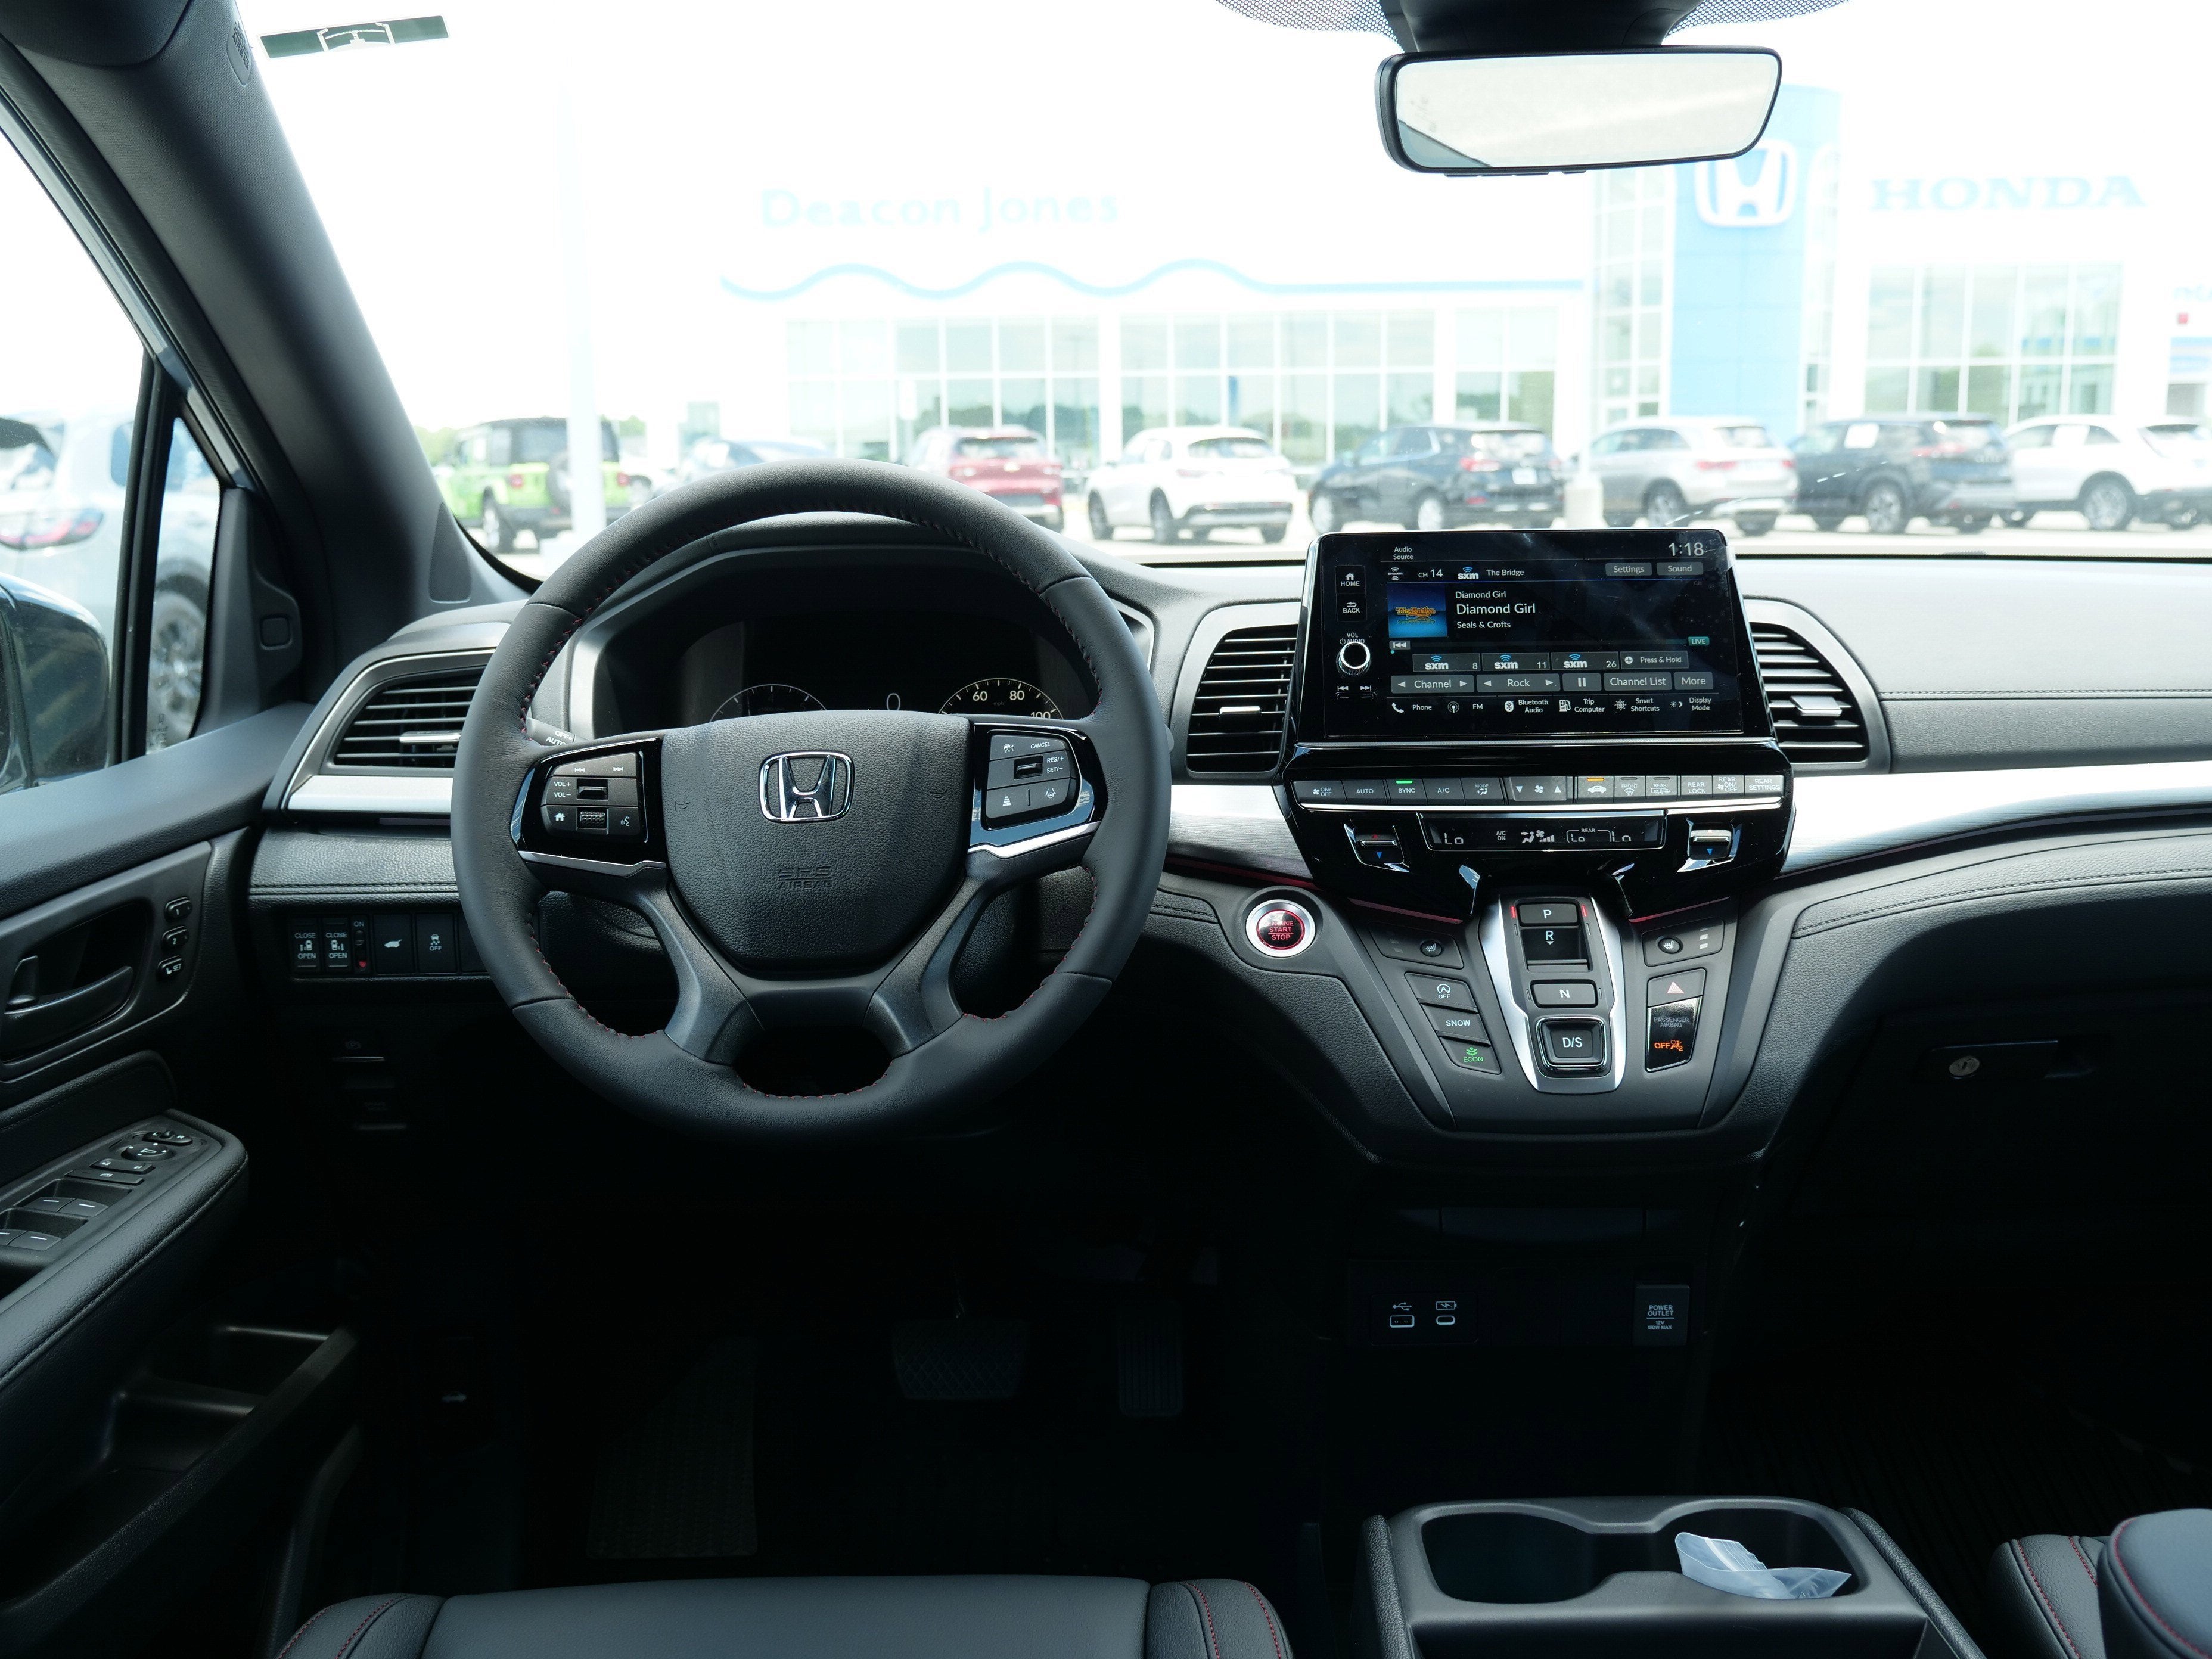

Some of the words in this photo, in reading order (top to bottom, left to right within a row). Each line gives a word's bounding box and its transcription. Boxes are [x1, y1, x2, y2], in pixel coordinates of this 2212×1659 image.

[1869, 175, 2149, 213] HONDA
[761, 188, 961, 228] Deacon
[977, 185, 1119, 234] Jones
[1669, 542, 1704, 557] 1:18
[1430, 569, 1443, 578] 14
[1502, 569, 1524, 577] Bridge
[1613, 566, 1645, 574] Settings
[1455, 591, 1490, 599] Diamond
[1456, 604, 1511, 614] Diamond
[1514, 603, 1536, 614] Girl
[1563, 660, 1587, 669] sxm
[1414, 679, 1452, 688] Channel
[1507, 679, 1530, 687] Rock
[1610, 677, 1647, 686] Channel
[1649, 677, 1667, 686] List
[1681, 676, 1706, 685] More
[973, 691, 988, 701] 60
[1009, 690, 1024, 701] 80
[1030, 711, 1051, 719] 100
[554, 731, 568, 739] OFF
[1444, 832, 1464, 844] Lo
[1571, 833, 1585, 843] Lo
[778, 880, 833, 890] AIRBAG
[1543, 909, 1552, 919] P
[1545, 930, 1554, 940] R
[1559, 989, 1570, 998] N
[1562, 1037, 1583, 1048] D/S
